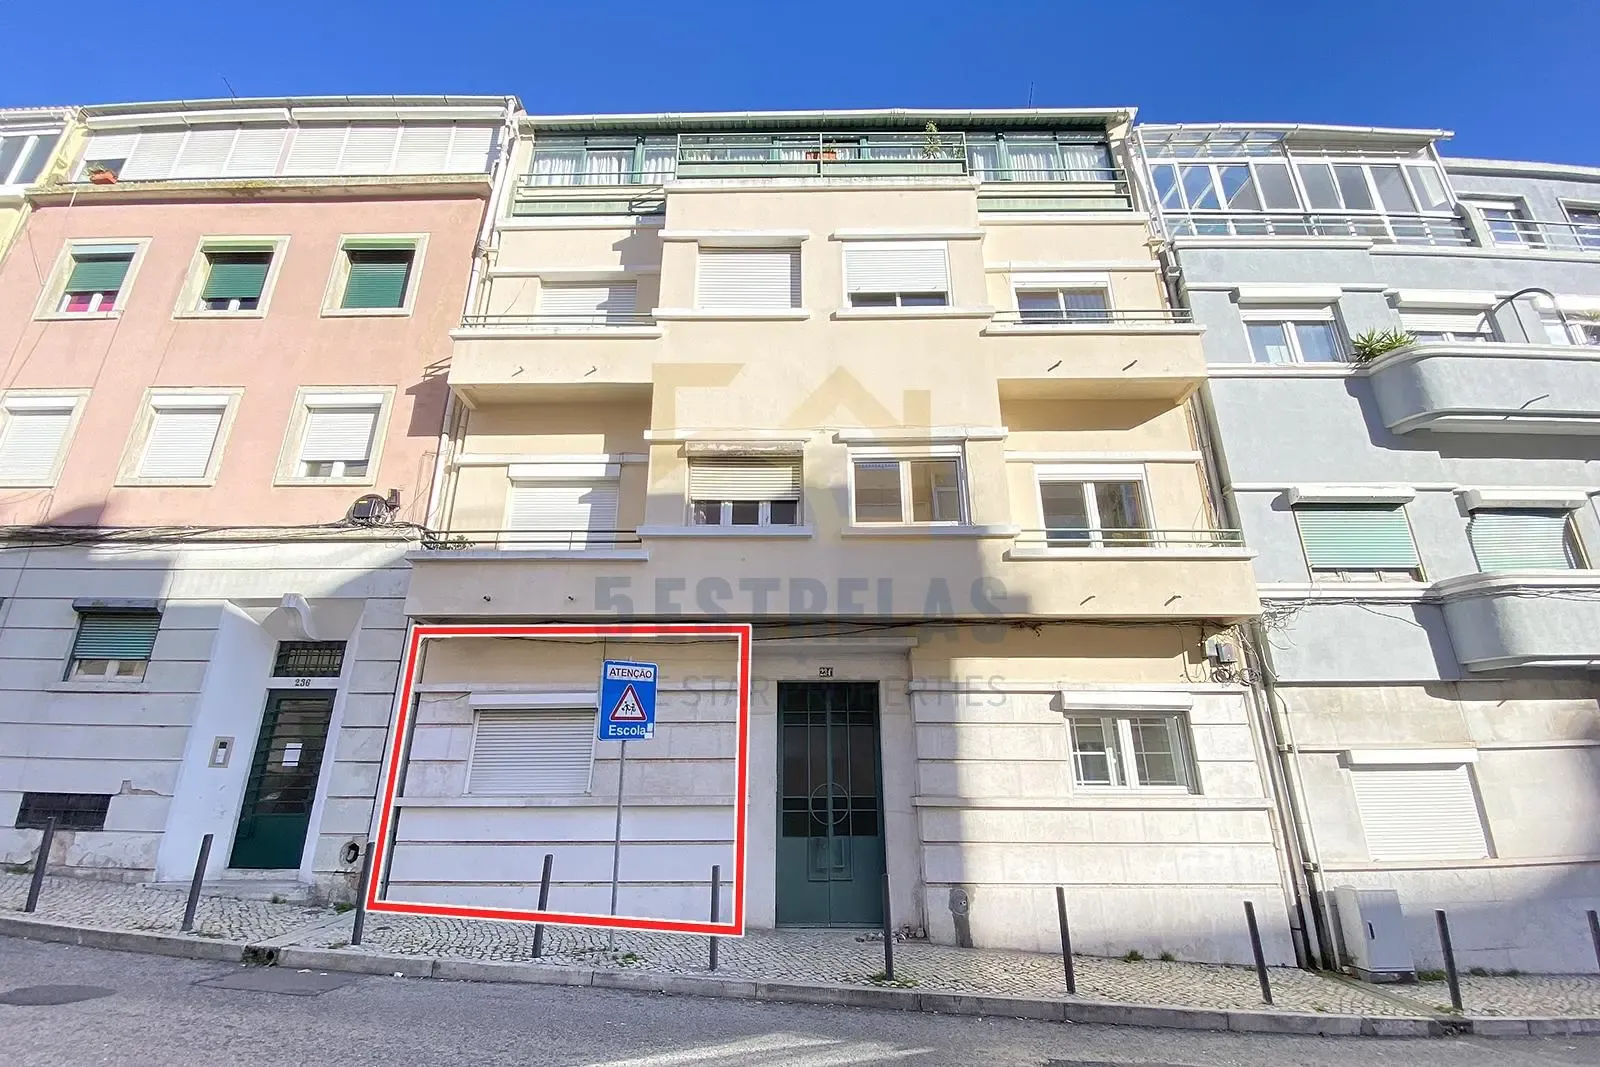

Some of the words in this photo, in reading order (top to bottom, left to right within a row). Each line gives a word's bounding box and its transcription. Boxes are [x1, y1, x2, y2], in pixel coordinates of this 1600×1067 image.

[609, 667, 653, 679] ATENÇÃO
[294, 678, 312, 687] 236
[608, 724, 646, 736] Escola
